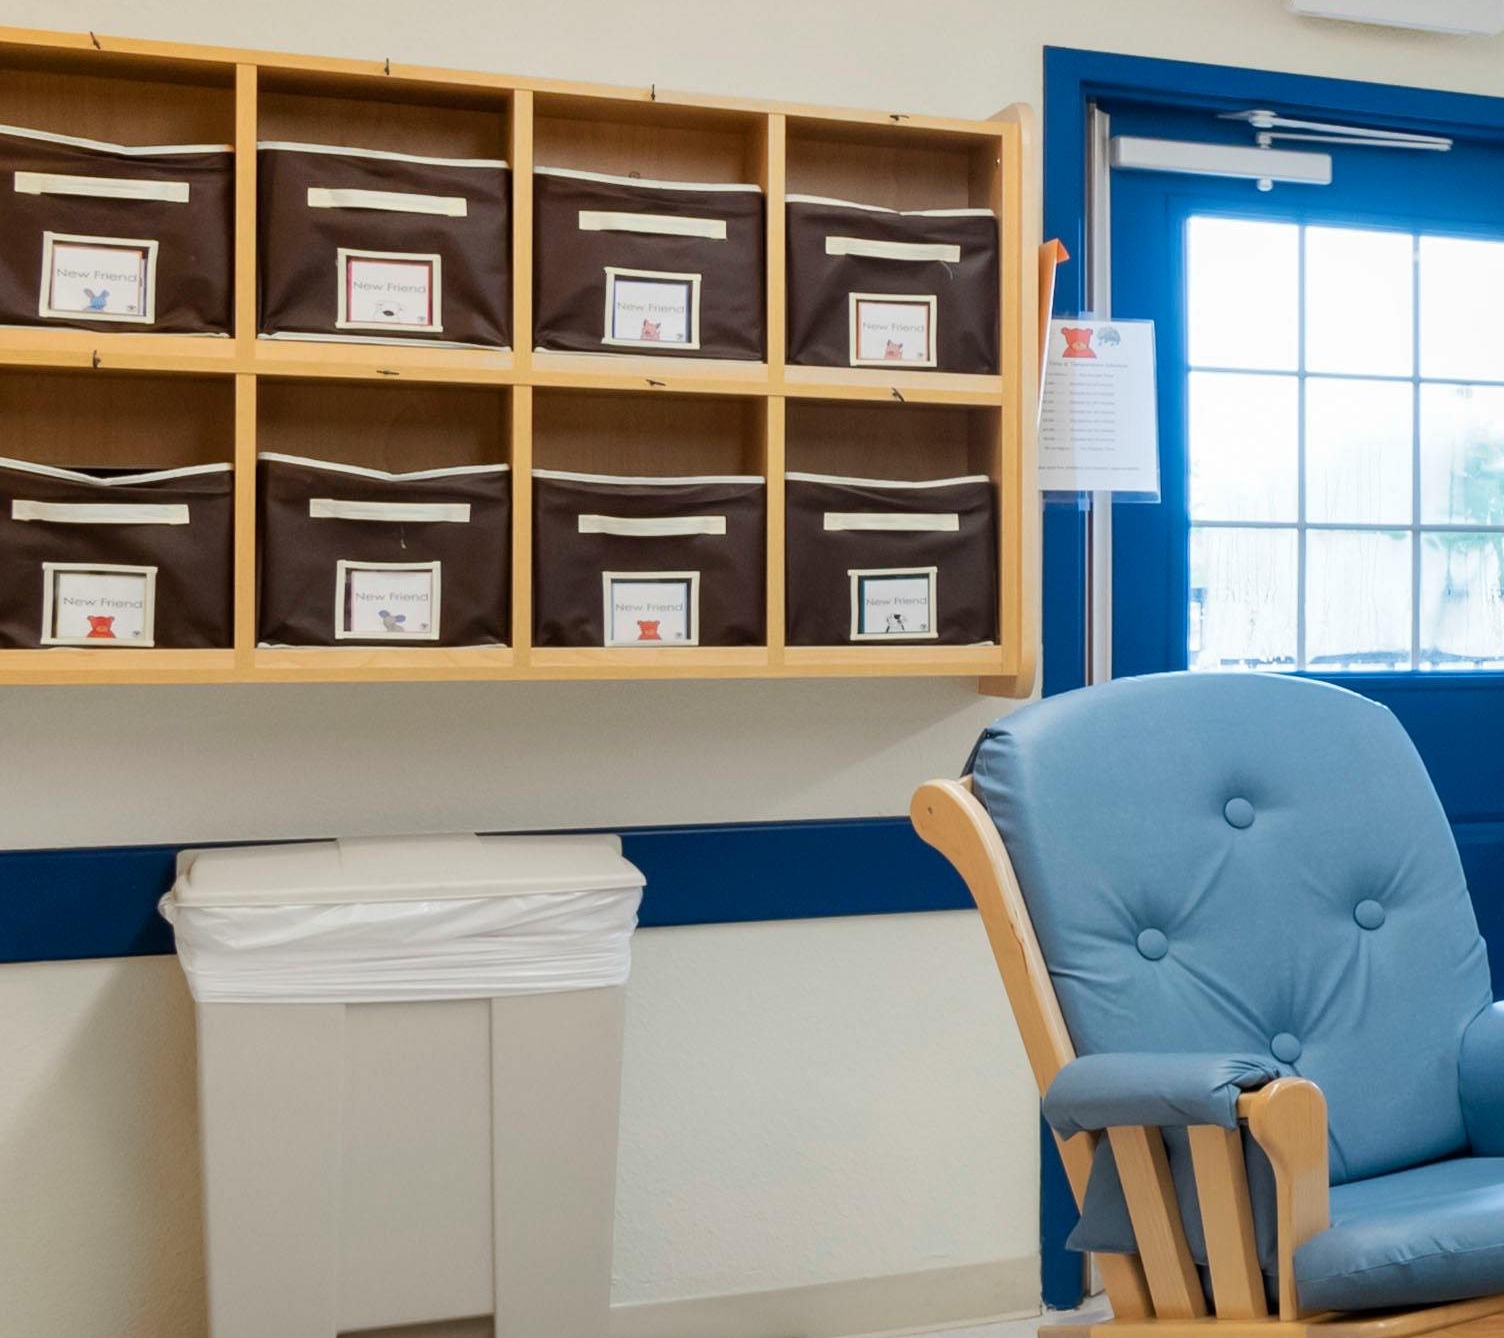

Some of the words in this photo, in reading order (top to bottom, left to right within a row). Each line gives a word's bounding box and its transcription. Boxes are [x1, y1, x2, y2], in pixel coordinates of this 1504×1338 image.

[56, 267, 90, 279] New
[93, 268, 138, 283] Friend
[352, 279, 382, 293] New
[384, 280, 427, 294] Friend
[616, 301, 646, 312] New
[647, 301, 685, 314] Friend
[862, 321, 889, 331] New
[891, 322, 925, 334] Friend
[62, 596, 97, 608] New
[99, 597, 144, 610] Friend
[355, 591, 386, 602] New
[389, 591, 429, 603] Friend
[865, 597, 891, 606] New
[894, 596, 928, 606] Friend
[615, 602, 644, 613] New
[646, 602, 684, 613] Friend
